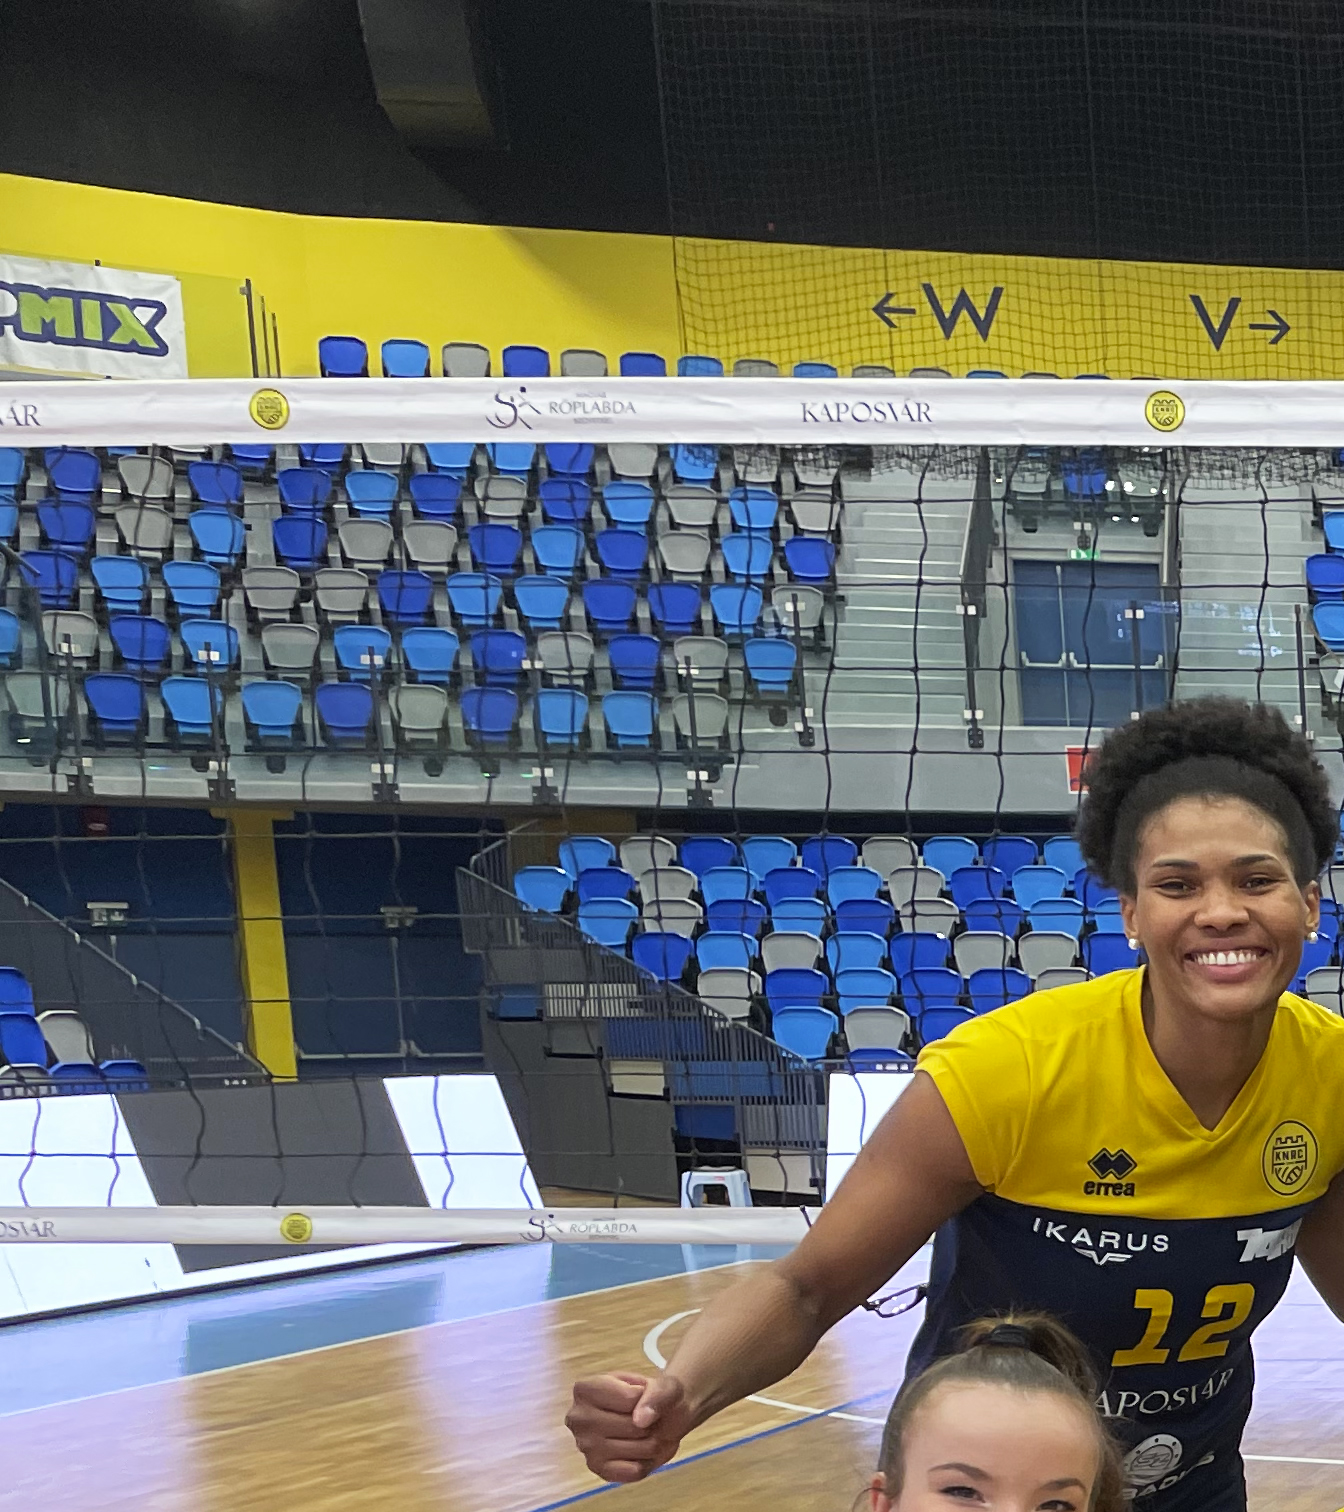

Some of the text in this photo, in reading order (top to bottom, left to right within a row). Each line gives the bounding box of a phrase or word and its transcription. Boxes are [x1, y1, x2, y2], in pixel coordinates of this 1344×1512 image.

[920, 282, 1005, 343] W
[1188, 294, 1243, 352] V
[800, 399, 934, 423] KAPOSVÁR
[1275, 1148, 1304, 1162] KNRC
[1083, 1180, 1135, 1197] errea
[1032, 1217, 1170, 1253] IKARUS
[1111, 1282, 1256, 1368] 12
[1095, 1368, 1234, 1418] APOSVÁR
